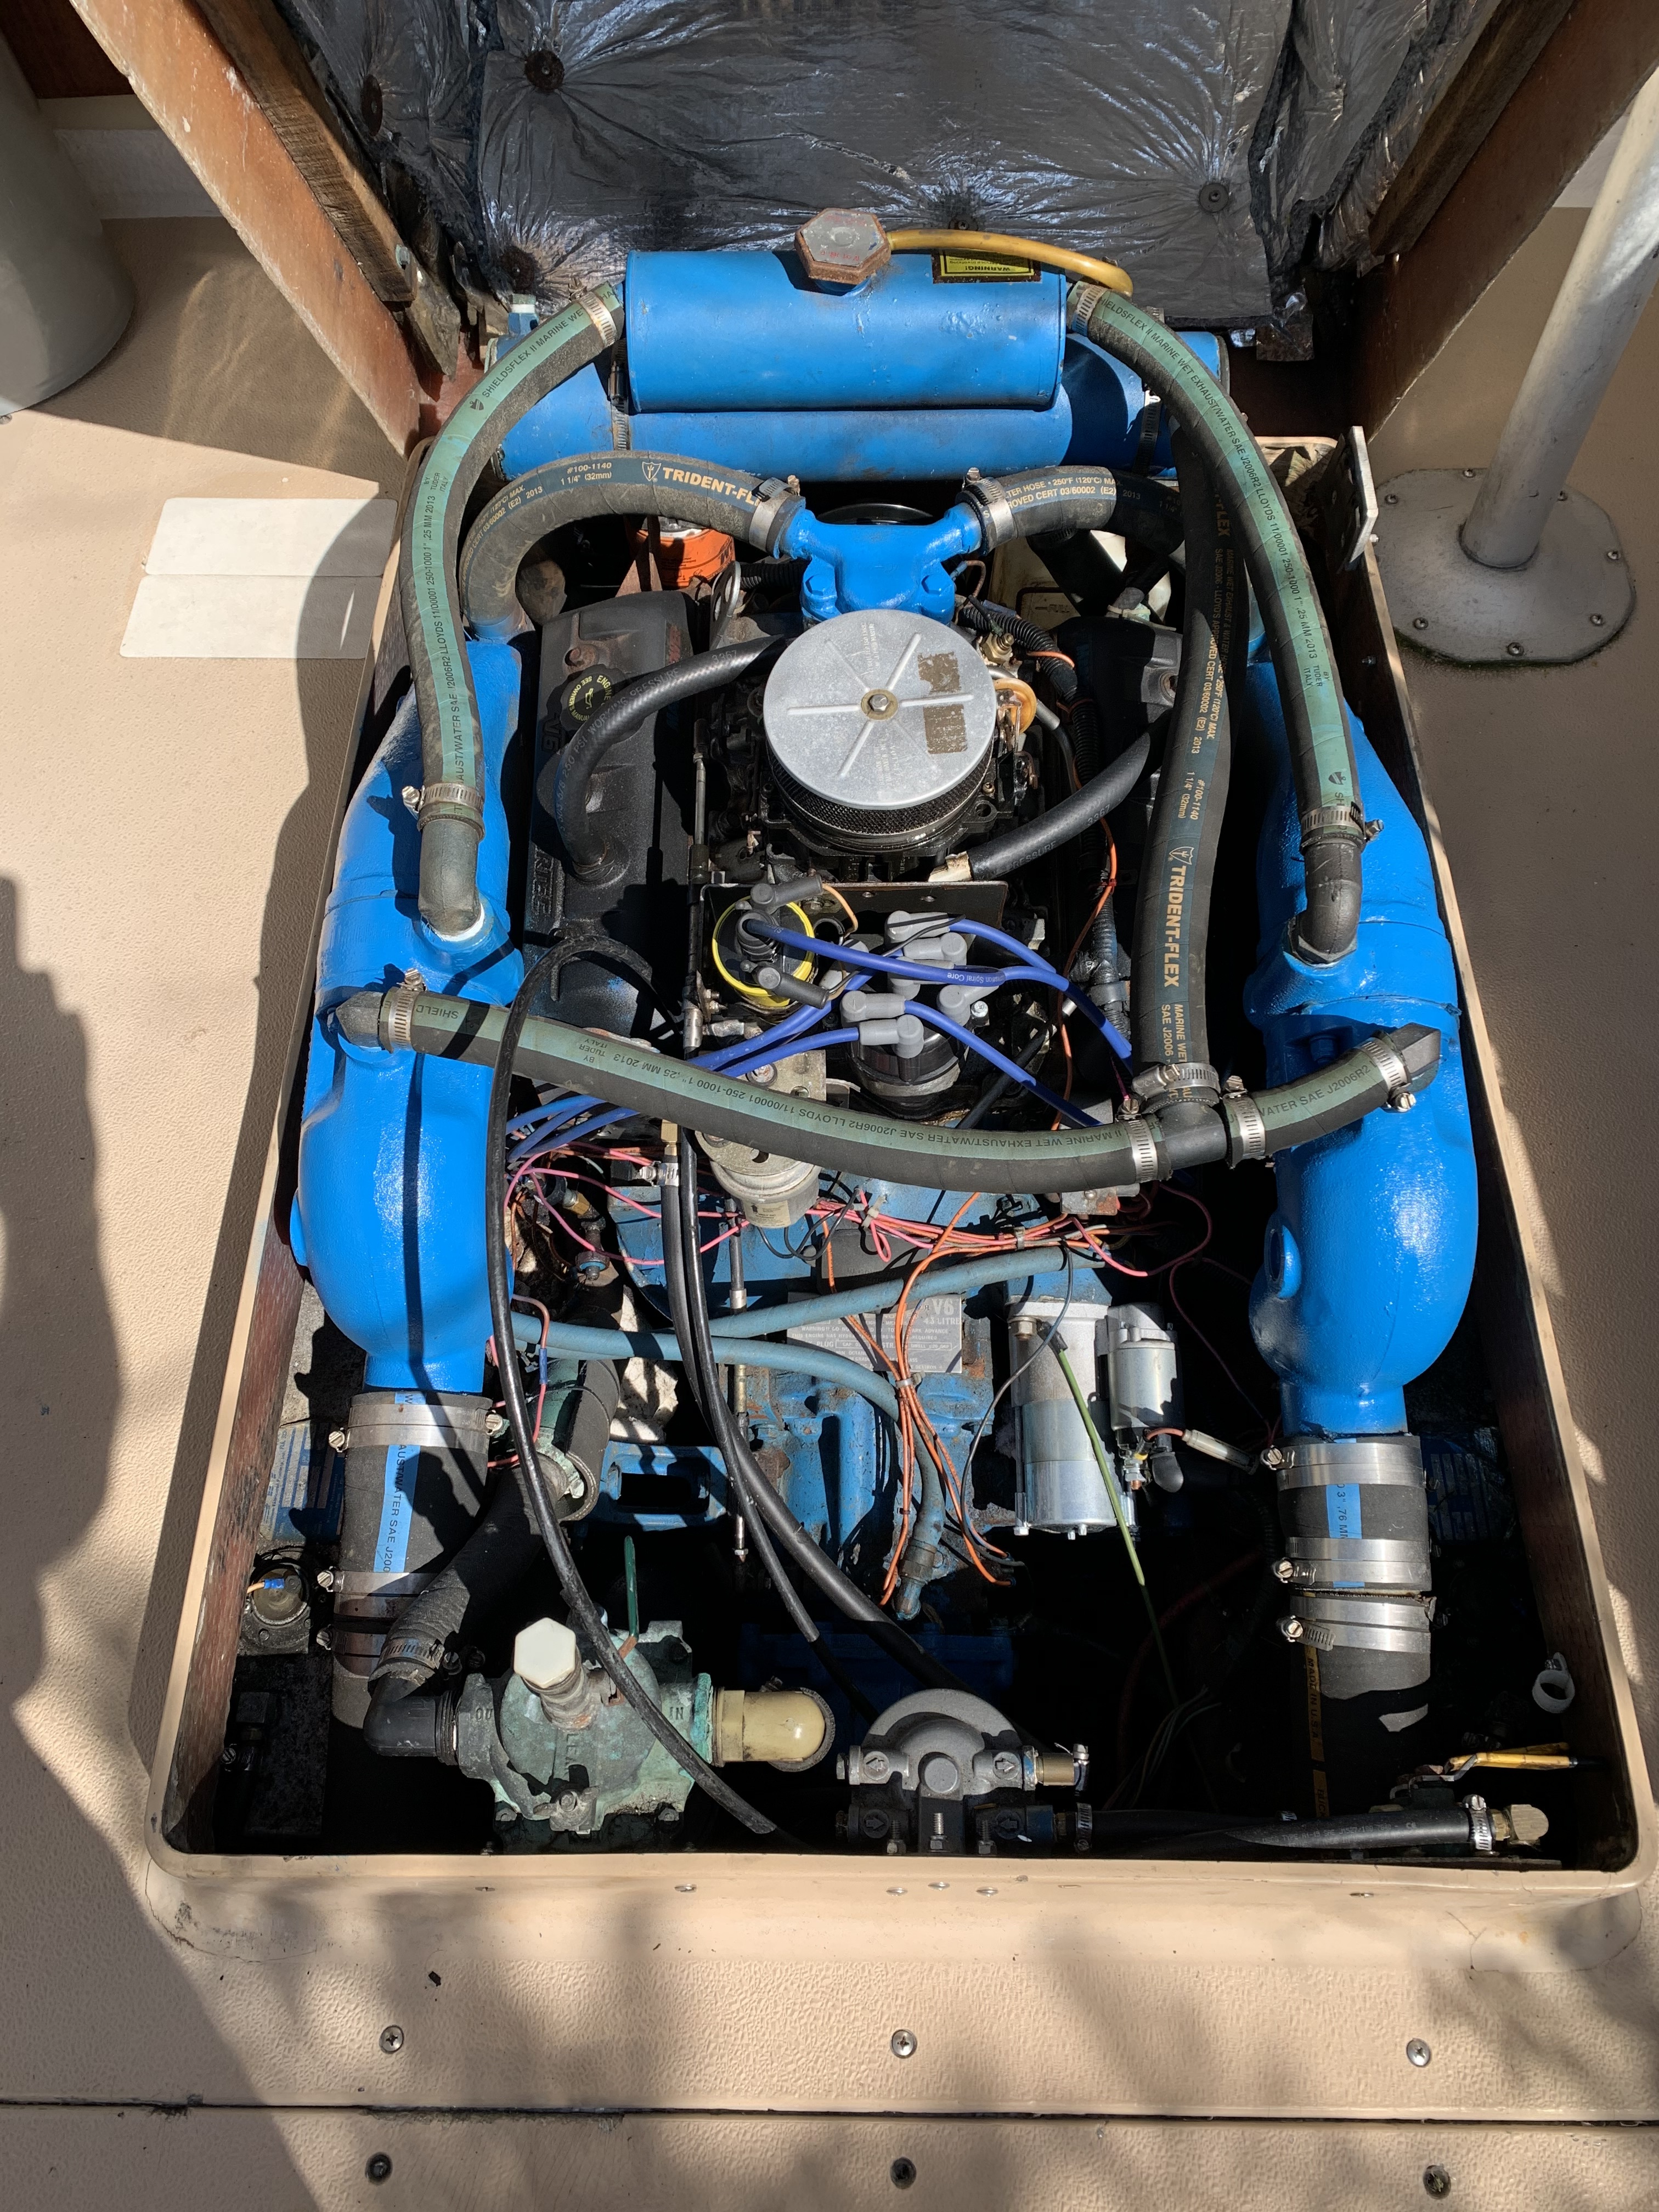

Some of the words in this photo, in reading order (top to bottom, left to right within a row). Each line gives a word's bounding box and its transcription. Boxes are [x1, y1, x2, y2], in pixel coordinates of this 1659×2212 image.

[1098, 298, 1147, 331] HIELDSFLEX
[1151, 332, 1180, 360] MARINE
[482, 350, 532, 398] SHIELDSFLEX
[535, 320, 569, 347] MARINE
[1177, 358, 1194, 375] WET
[1190, 375, 1237, 439] EXHAUST/WATER
[1232, 438, 1246, 456] SAE
[566, 462, 612, 474] #100-1140
[584, 472, 612, 481] (32mm)
[1240, 452, 1262, 488] J2006R2
[423, 476, 431, 485] BY
[430, 472, 441, 490] TUDER
[439, 476, 449, 493] ITALY
[663, 467, 760, 506] TRIDENT-FL
[1023, 481, 1046, 493] HOSE
[507, 495, 522, 510] (E2)
[526, 486, 544, 499] 2013
[1036, 489, 1058, 503] CERT
[1060, 487, 1096, 495] 03/60002
[1100, 486, 1117, 496] (E2)
[1122, 489, 1141, 500] 2013
[425, 495, 436, 514] 2013
[1255, 488, 1276, 522] LLOYDS
[423, 515, 432, 529] MM
[1269, 521, 1289, 556] 11/00001
[1215, 548, 1223, 563] SAE
[423, 550, 435, 586] 250-1000
[1214, 564, 1223, 585] J2006
[1282, 558, 1301, 595] 250-1000
[1226, 576, 1234, 591] WET
[427, 586, 442, 619] 11/00001
[435, 620, 449, 654] LLOYDS
[1300, 620, 1311, 637] MM
[1305, 637, 1318, 659] 2013
[443, 656, 456, 692] J2006R2
[580, 675, 592, 686] SEE
[1205, 661, 1216, 681] CERT
[1303, 667, 1314, 686] ITALY
[1312, 664, 1323, 687] TUDER
[596, 675, 612, 701] ENGINE
[448, 691, 460, 712] SAE
[1199, 682, 1212, 714] 03/60002
[1195, 716, 1206, 731] (E2)
[573, 735, 588, 755] PSI
[1191, 736, 1203, 754] 2013
[1177, 792, 1191, 819] (32mm)
[1189, 778, 1206, 821] #100-1140
[1164, 865, 1187, 988] TRIDENT-FLEX
[947, 972, 970, 981] Core
[966, 974, 984, 984] Spiral
[1161, 1004, 1171, 1025] SAE
[1174, 1003, 1186, 1041] MARINE
[578, 1043, 606, 1058] TUDER
[584, 1039, 608, 1048] ITALY
[1162, 1026, 1174, 1057] J2006
[583, 1055, 595, 1064] BY
[613, 1053, 639, 1067] 2013
[641, 1062, 662, 1075] MM
[697, 1079, 747, 1099] 250-1000
[1300, 1089, 1325, 1106] SAE
[1326, 1064, 1371, 1095] J2006R2
[749, 1094, 795, 1114] 11/00001
[799, 1108, 846, 1127] LLOYDS
[848, 1119, 897, 1136] J2006R2
[899, 1130, 924, 1141] SAE
[927, 1133, 1032, 1148] EXHAUST/WATER
[1035, 1137, 1063, 1148] WET
[1065, 1131, 1113, 1146] MARINE
[931, 1297, 955, 1316] V6
[386, 1519, 398, 1543] SAE
[1307, 1657, 1317, 1690] MADE
[1310, 1694, 1318, 1705] IN
[669, 1707, 685, 1720] IN
